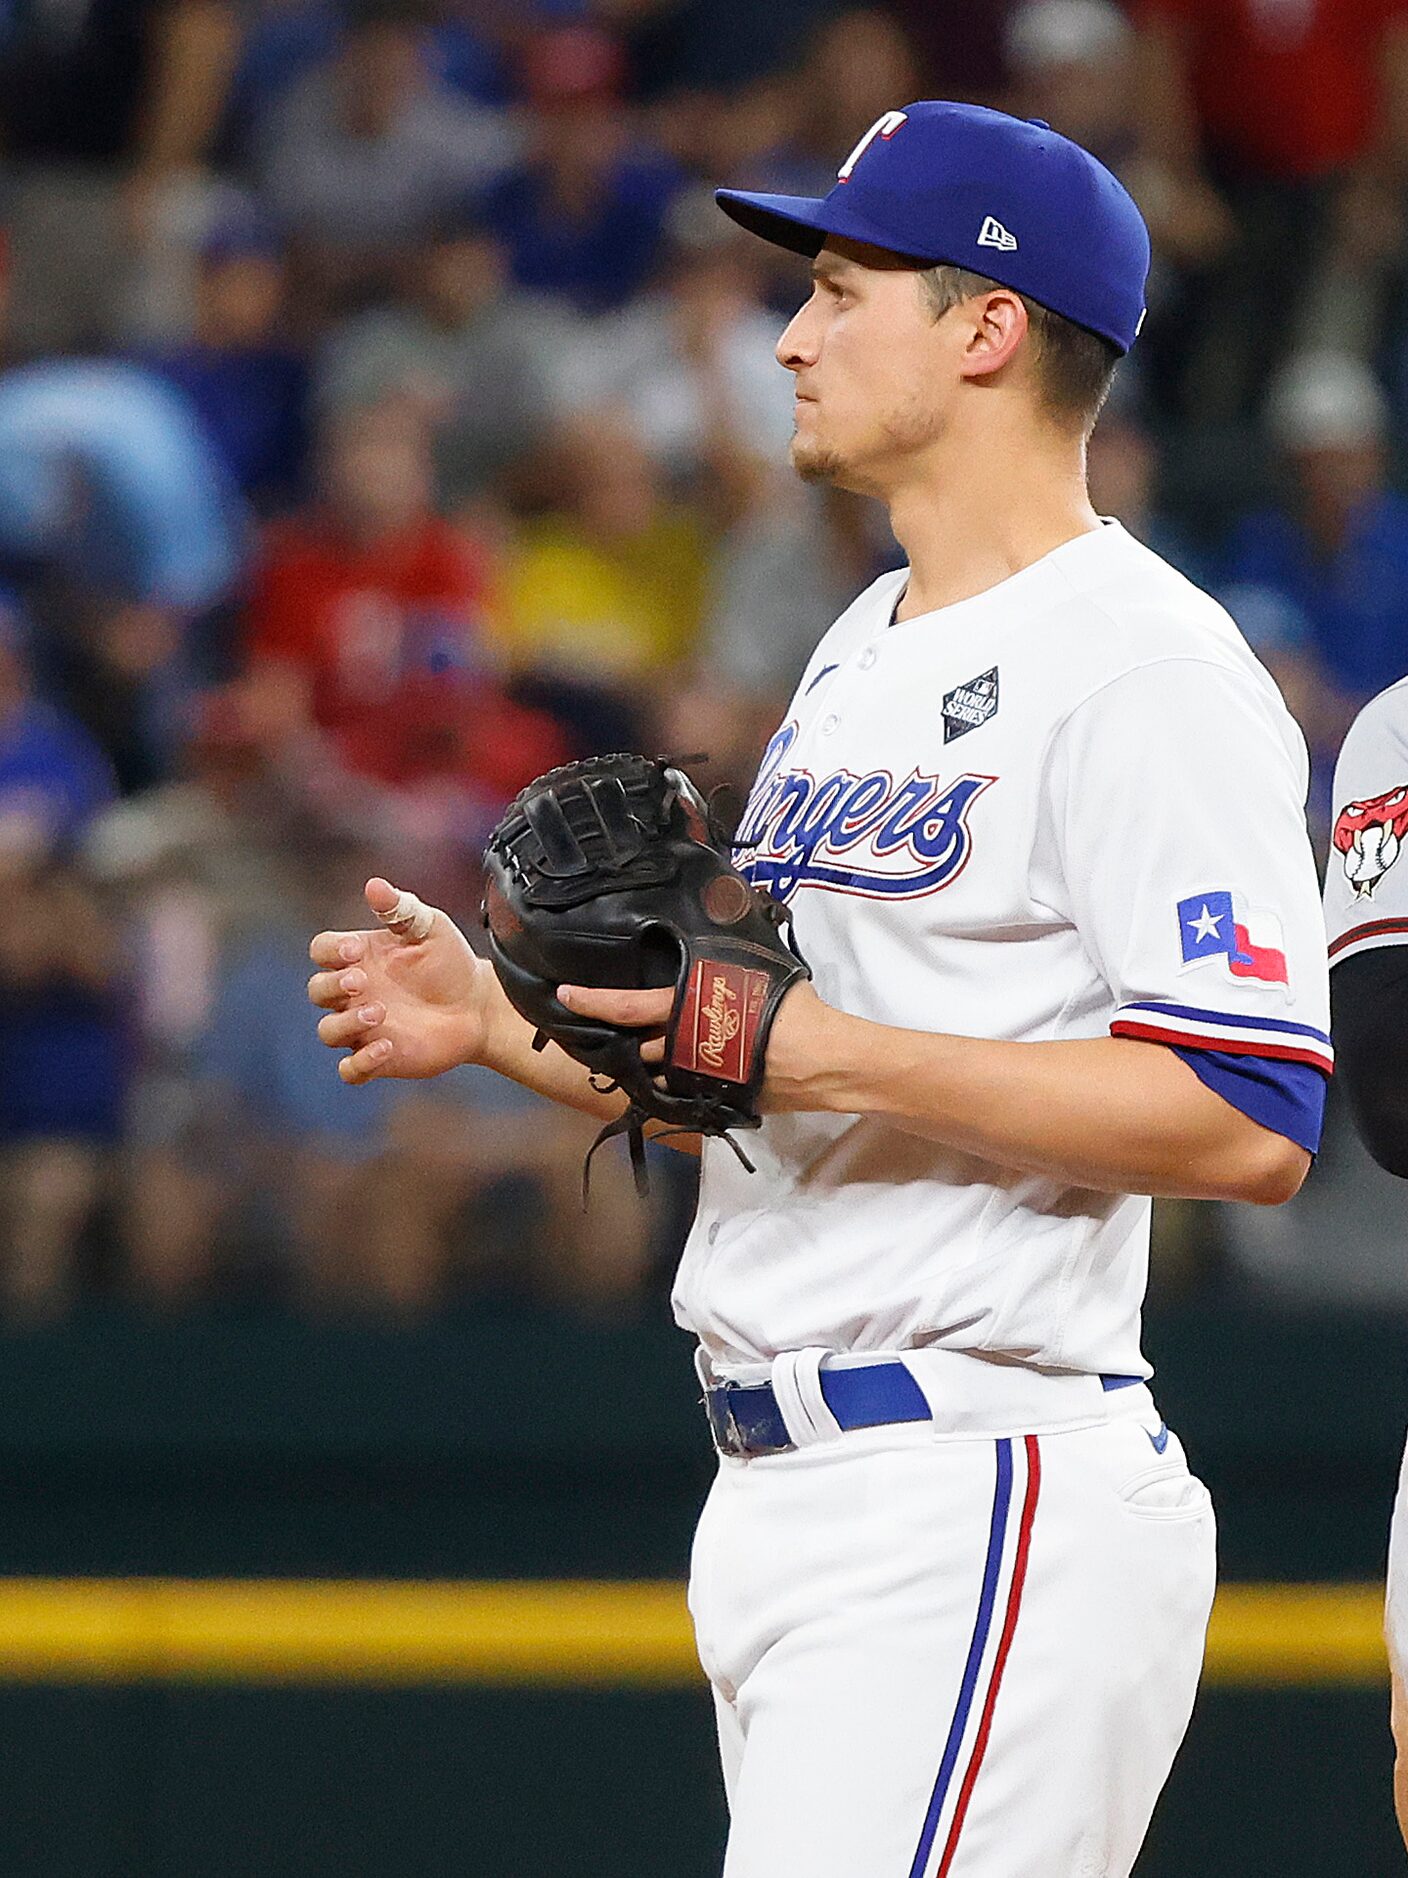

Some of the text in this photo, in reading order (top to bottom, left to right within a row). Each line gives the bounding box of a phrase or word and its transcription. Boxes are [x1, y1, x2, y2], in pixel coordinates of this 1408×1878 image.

[953, 687, 996, 712] WORLD
[943, 701, 988, 726] SERIES
[699, 976, 737, 1068] Rawlings
